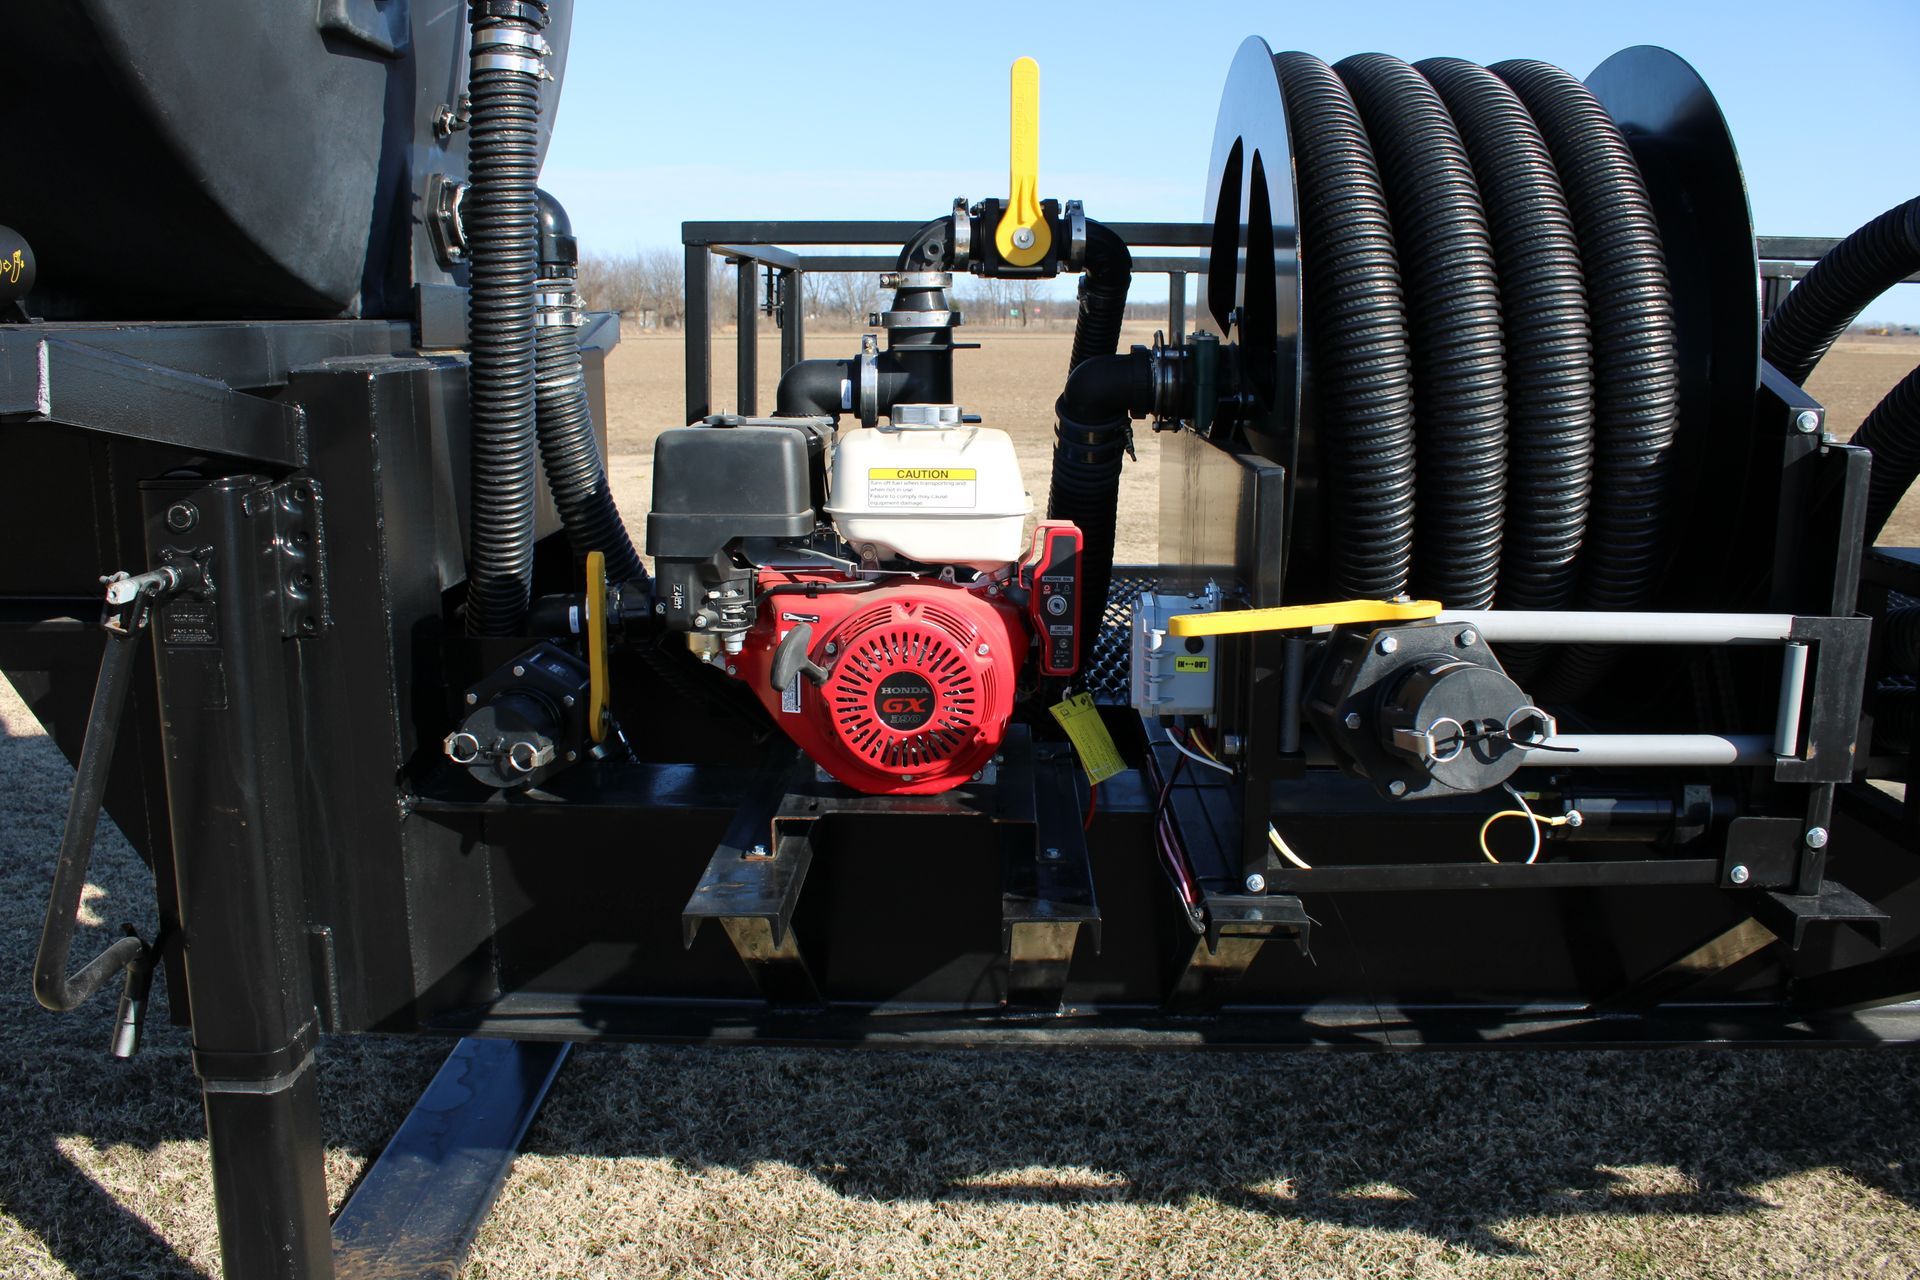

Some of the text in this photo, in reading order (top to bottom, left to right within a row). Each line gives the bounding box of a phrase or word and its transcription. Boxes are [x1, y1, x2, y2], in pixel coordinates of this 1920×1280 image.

[896, 469, 949, 479] CAUTION
[1194, 661, 1207, 669] OUT
[882, 698, 928, 713] GX
